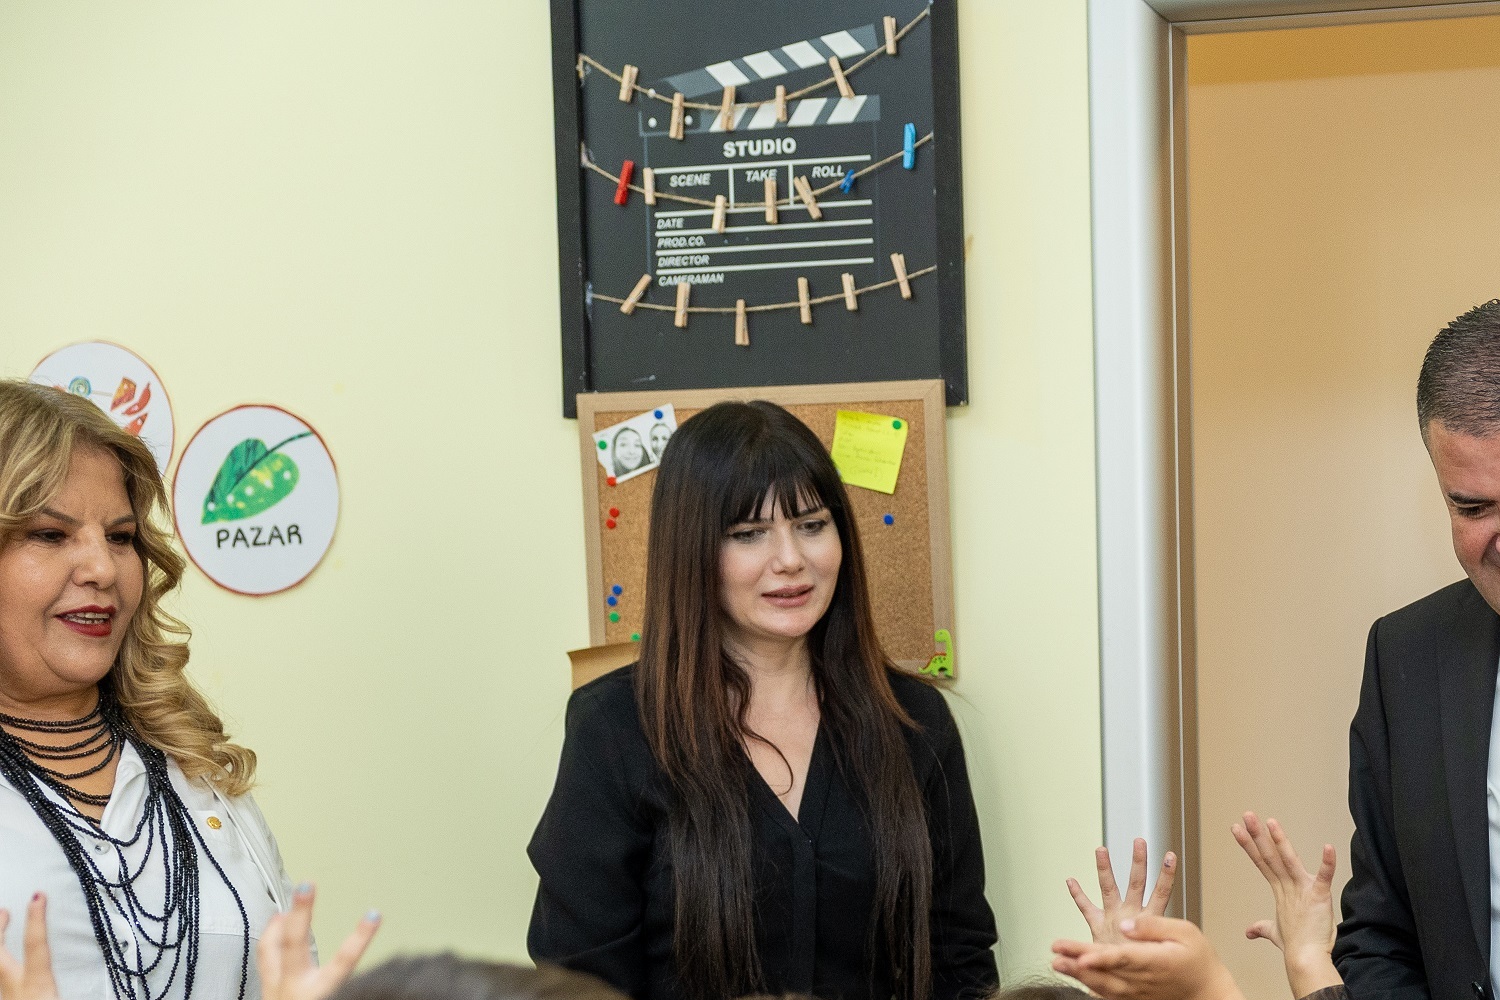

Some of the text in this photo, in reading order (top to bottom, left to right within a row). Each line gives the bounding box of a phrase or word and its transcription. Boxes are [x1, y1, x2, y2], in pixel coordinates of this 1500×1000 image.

[722, 137, 797, 158] STUDIO
[669, 165, 845, 188] SCENE TAKE ROLL
[656, 218, 684, 230] DATE
[656, 236, 707, 248] PROD.CO.
[657, 254, 711, 268] DIRECTOR
[658, 273, 725, 287] CAMERAMAN
[216, 524, 304, 549] PAZAR
